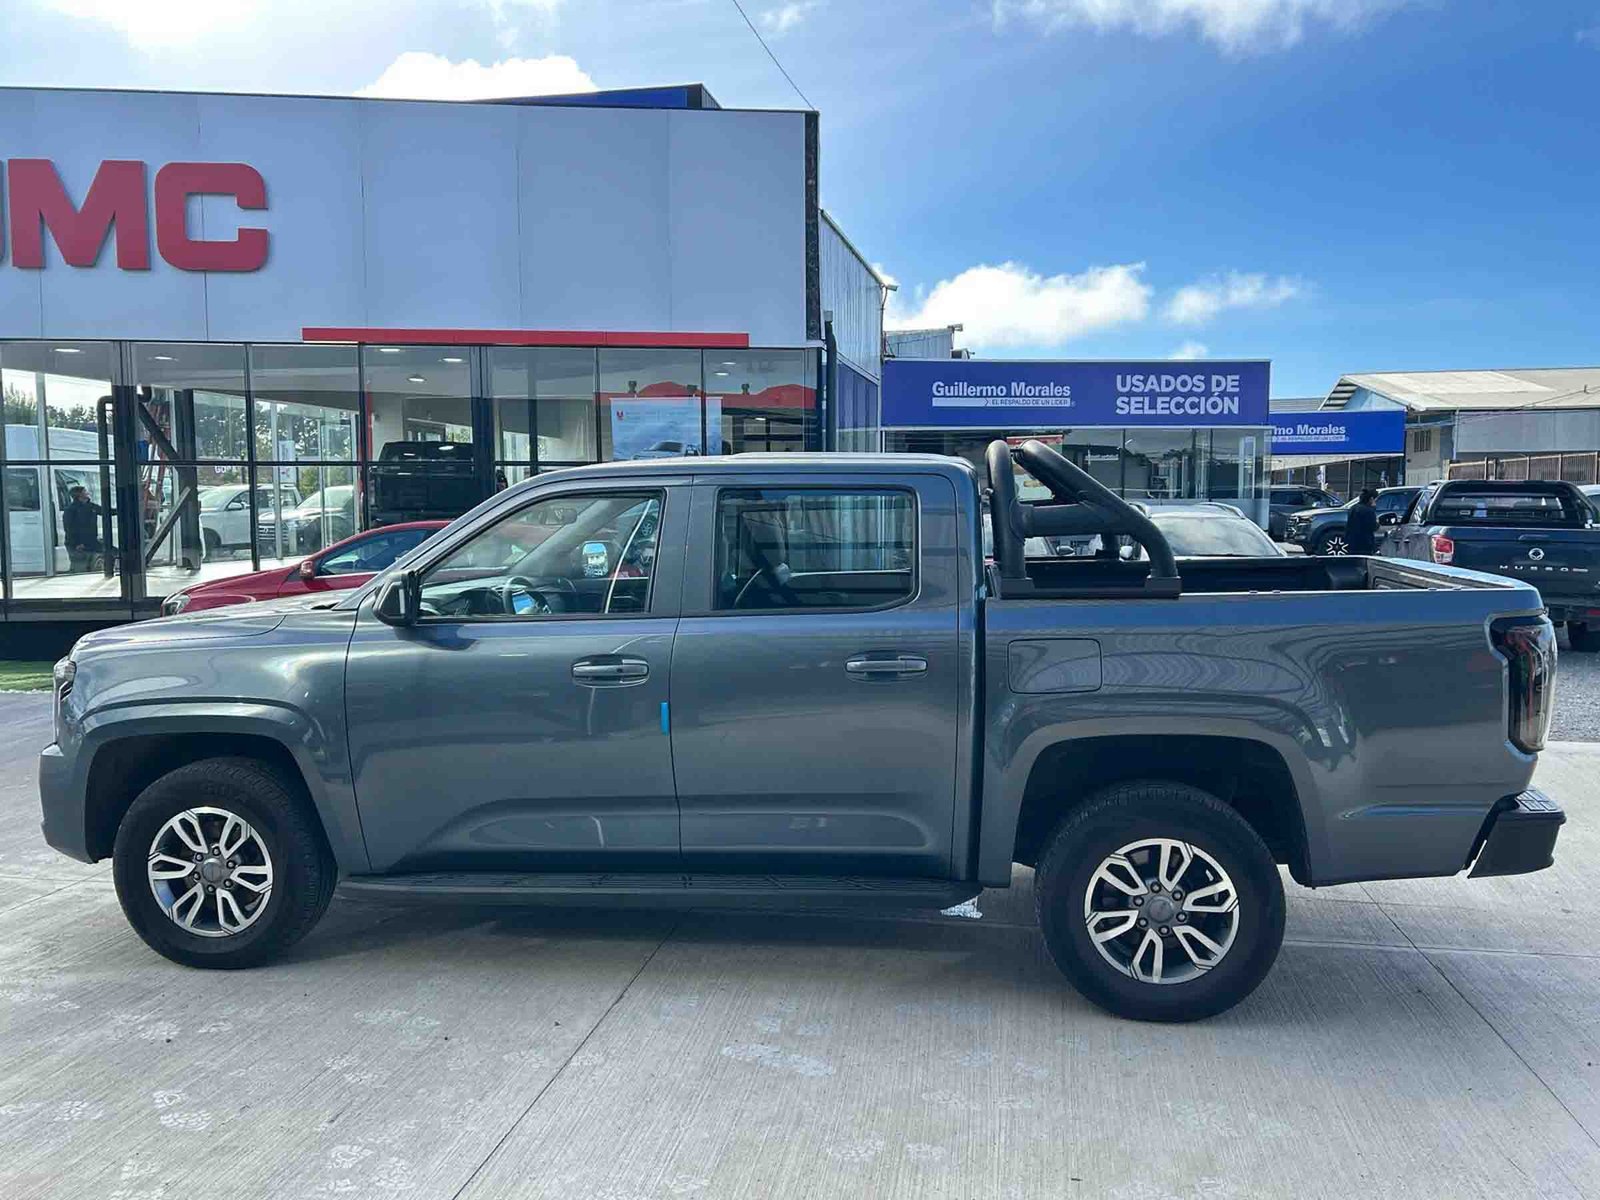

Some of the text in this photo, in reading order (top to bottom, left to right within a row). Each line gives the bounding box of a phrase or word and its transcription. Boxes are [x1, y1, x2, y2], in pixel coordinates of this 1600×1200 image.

[0, 159, 270, 272] MC
[932, 381, 1071, 396] Guillermo Morales
[1116, 374, 1240, 392] USADOS DE
[1116, 392, 1239, 414] SELECCIÓN
[1297, 423, 1346, 435] Morales
